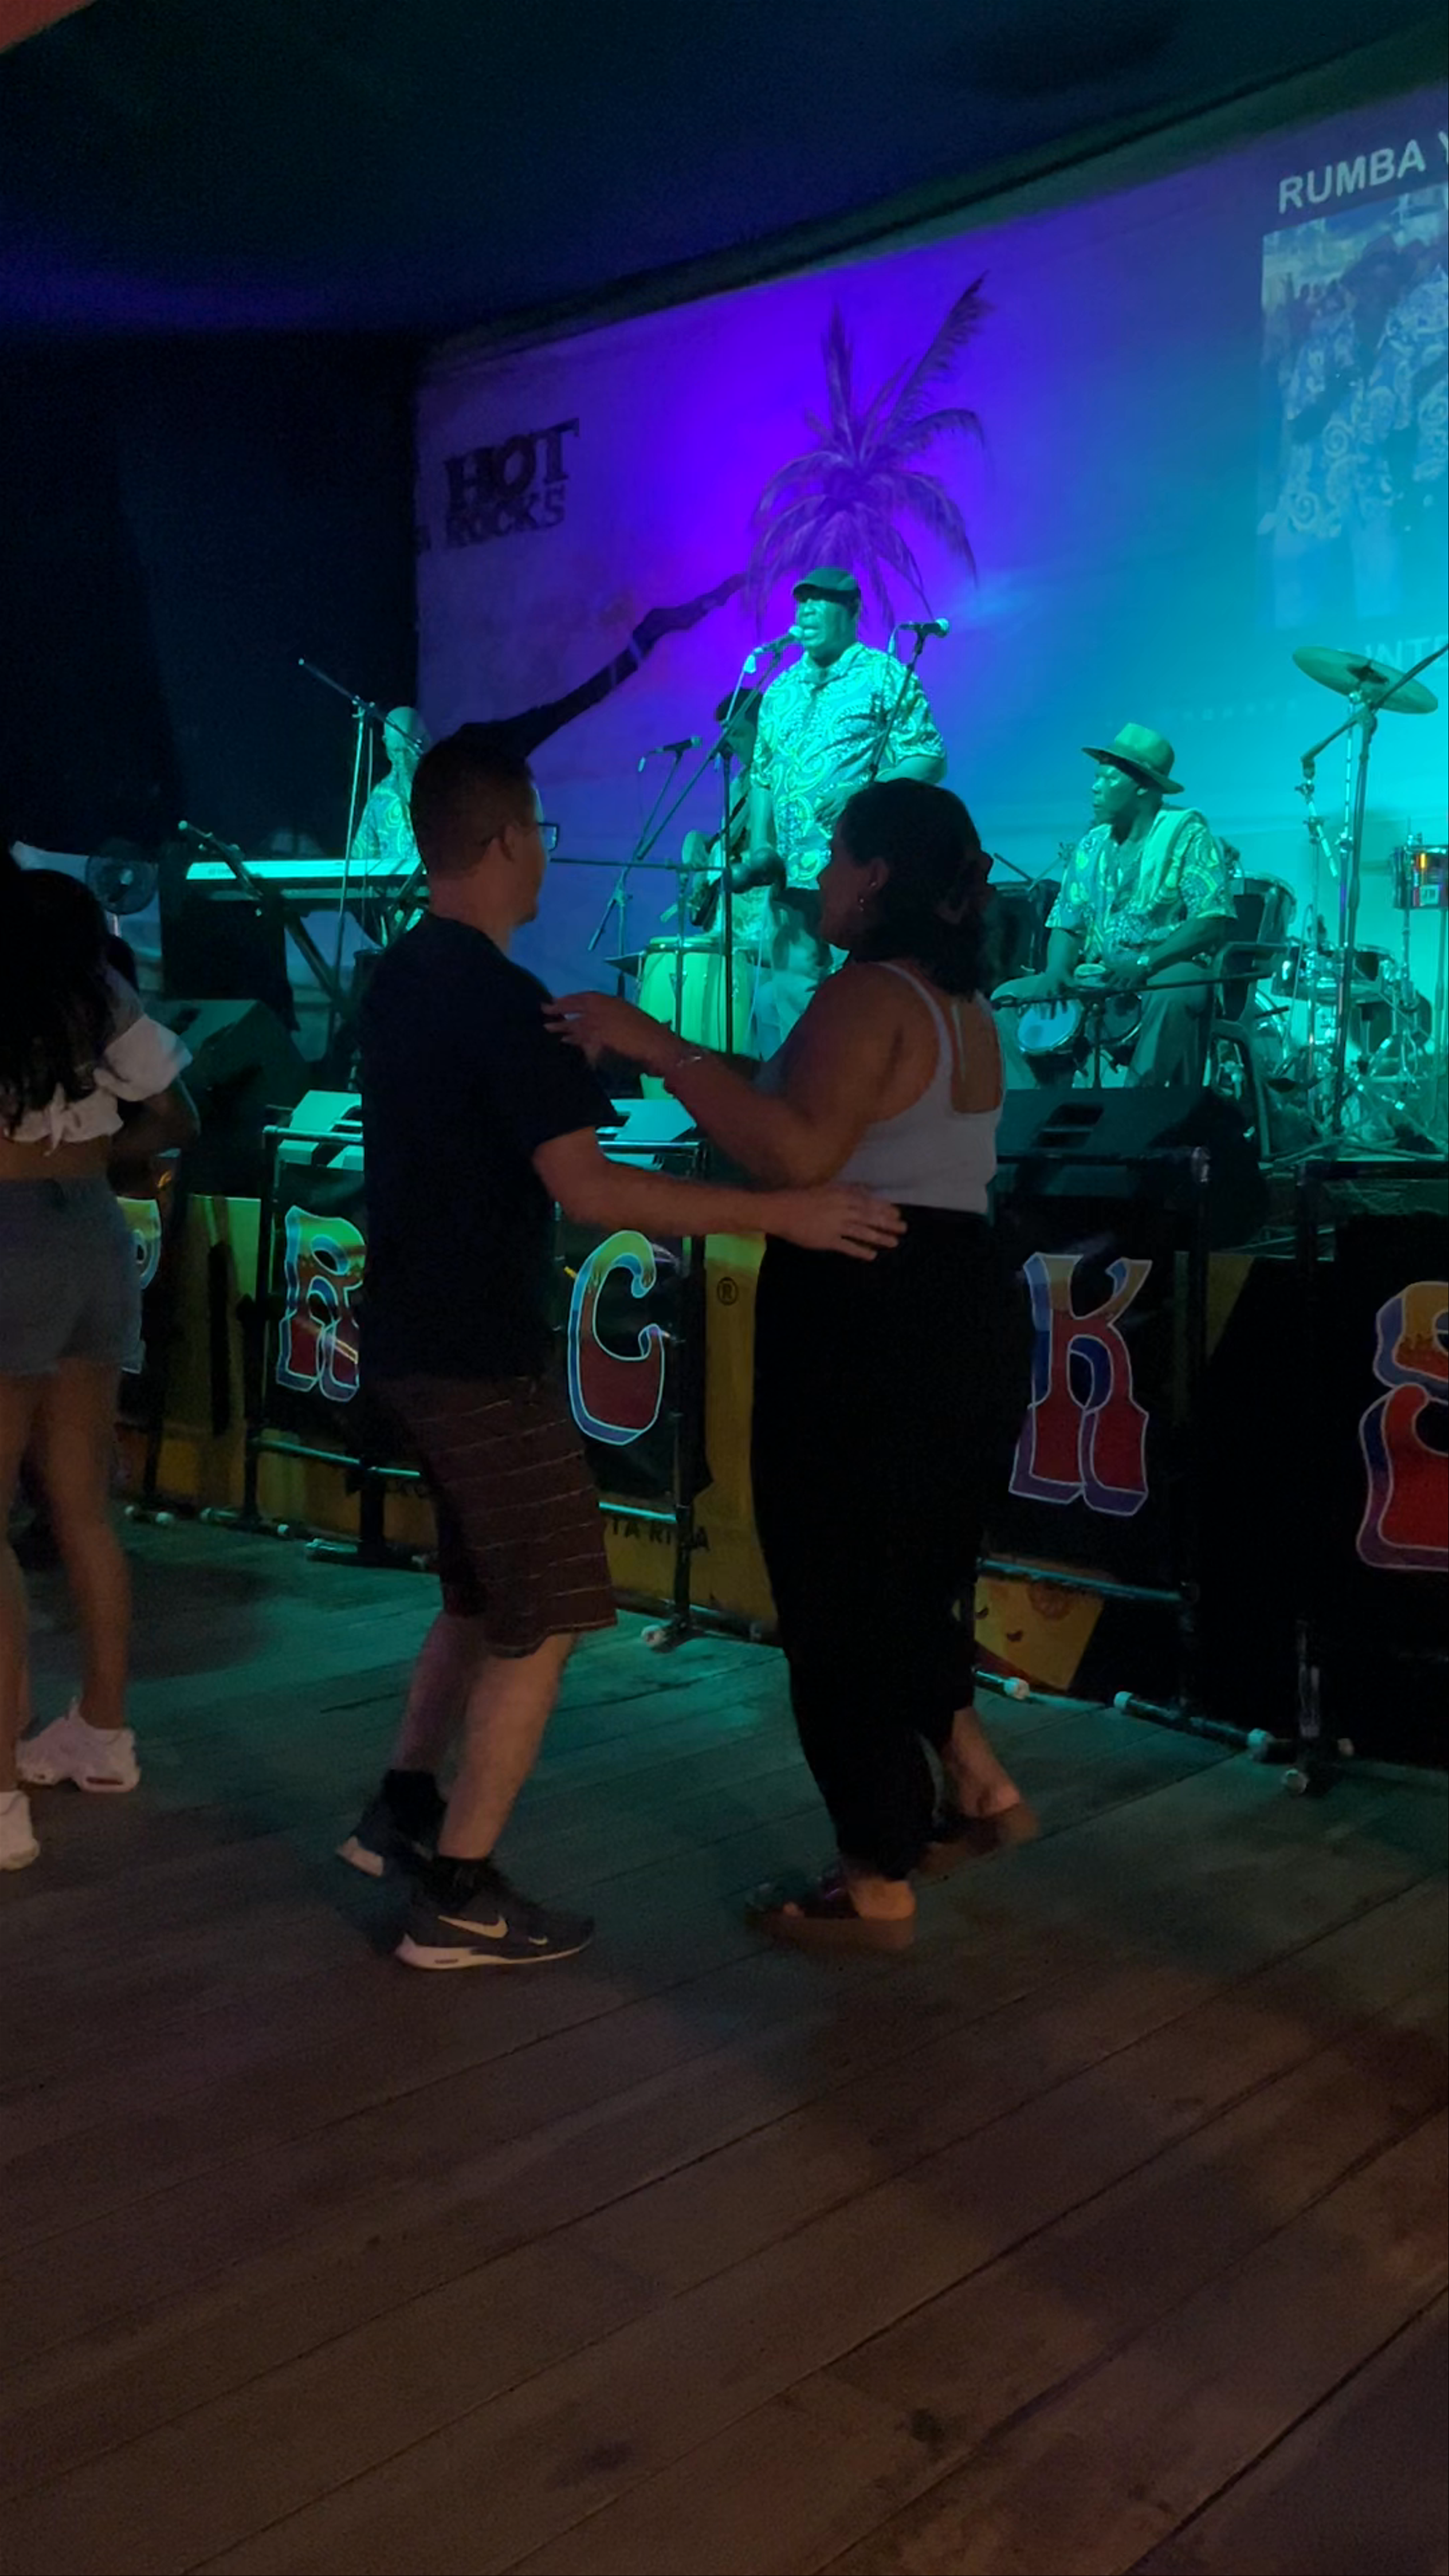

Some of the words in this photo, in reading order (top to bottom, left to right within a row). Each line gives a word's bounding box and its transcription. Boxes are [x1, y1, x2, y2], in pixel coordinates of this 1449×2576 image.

[1278, 138, 1426, 214] RUMBA
[443, 417, 580, 508] HOT
[445, 485, 567, 549] ROCKS
